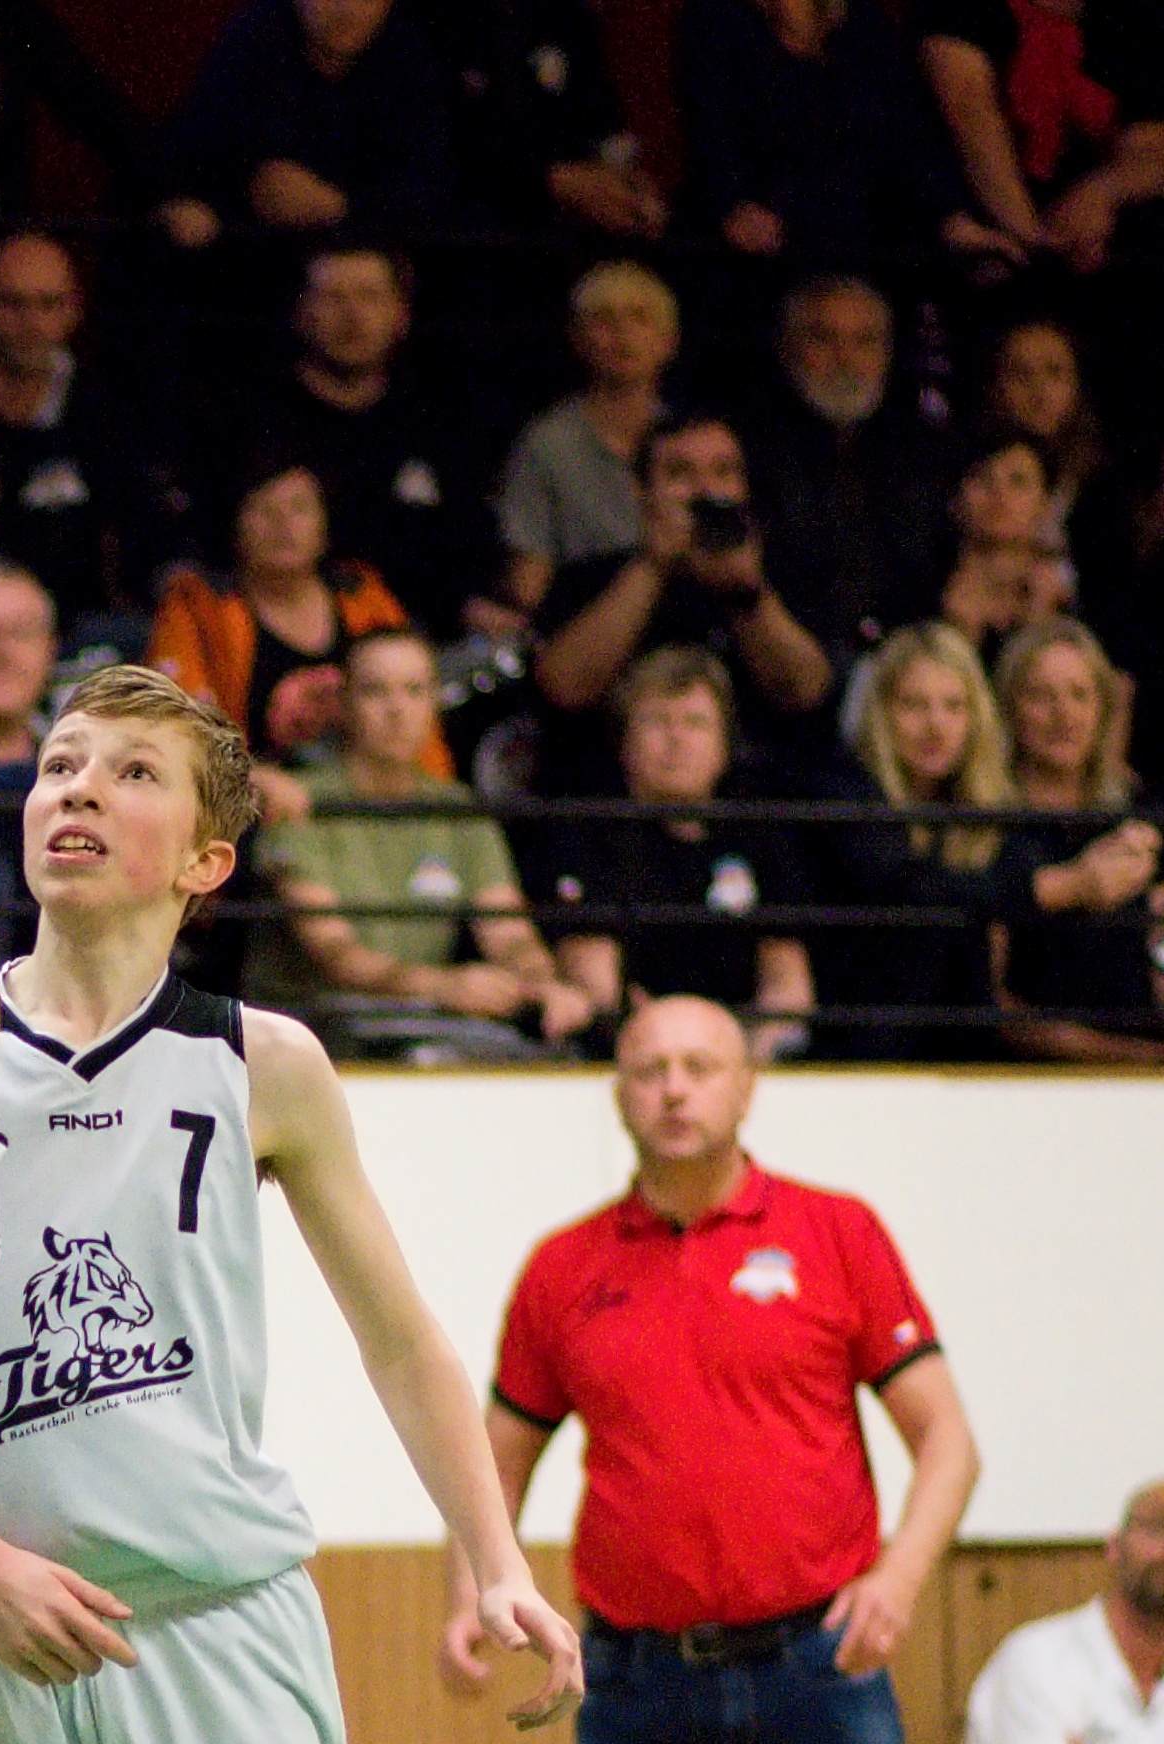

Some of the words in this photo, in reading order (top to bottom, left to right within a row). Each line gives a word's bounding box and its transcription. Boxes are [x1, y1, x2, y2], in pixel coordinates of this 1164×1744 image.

[49, 1109, 123, 1132] AND1
[170, 1109, 217, 1234] 7
[9, 1411, 76, 1441] Basketball
